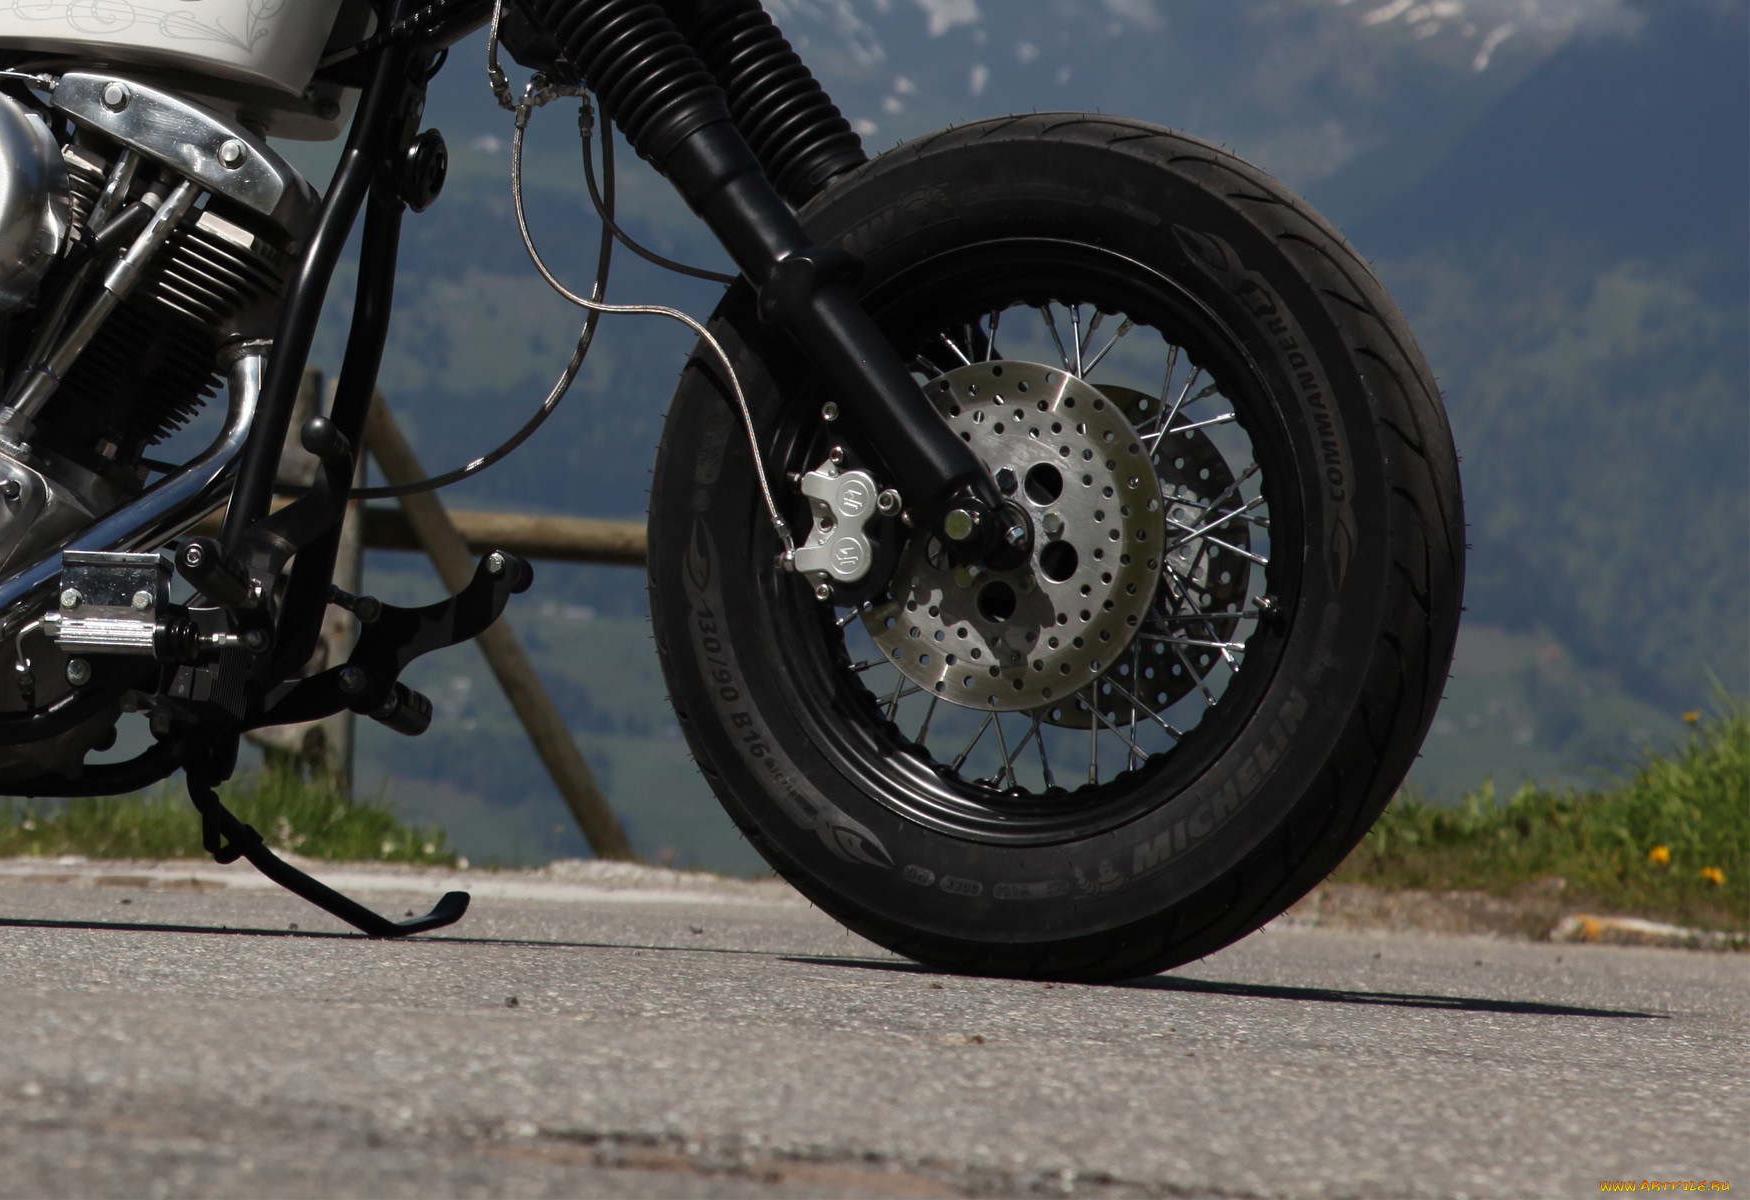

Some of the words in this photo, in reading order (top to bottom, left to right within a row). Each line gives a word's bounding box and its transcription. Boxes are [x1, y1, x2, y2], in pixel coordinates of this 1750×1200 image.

[1267, 316, 1345, 504] COMMANDER
[696, 599, 740, 703] 130/90
[1131, 685, 1309, 876] MICHELIN
